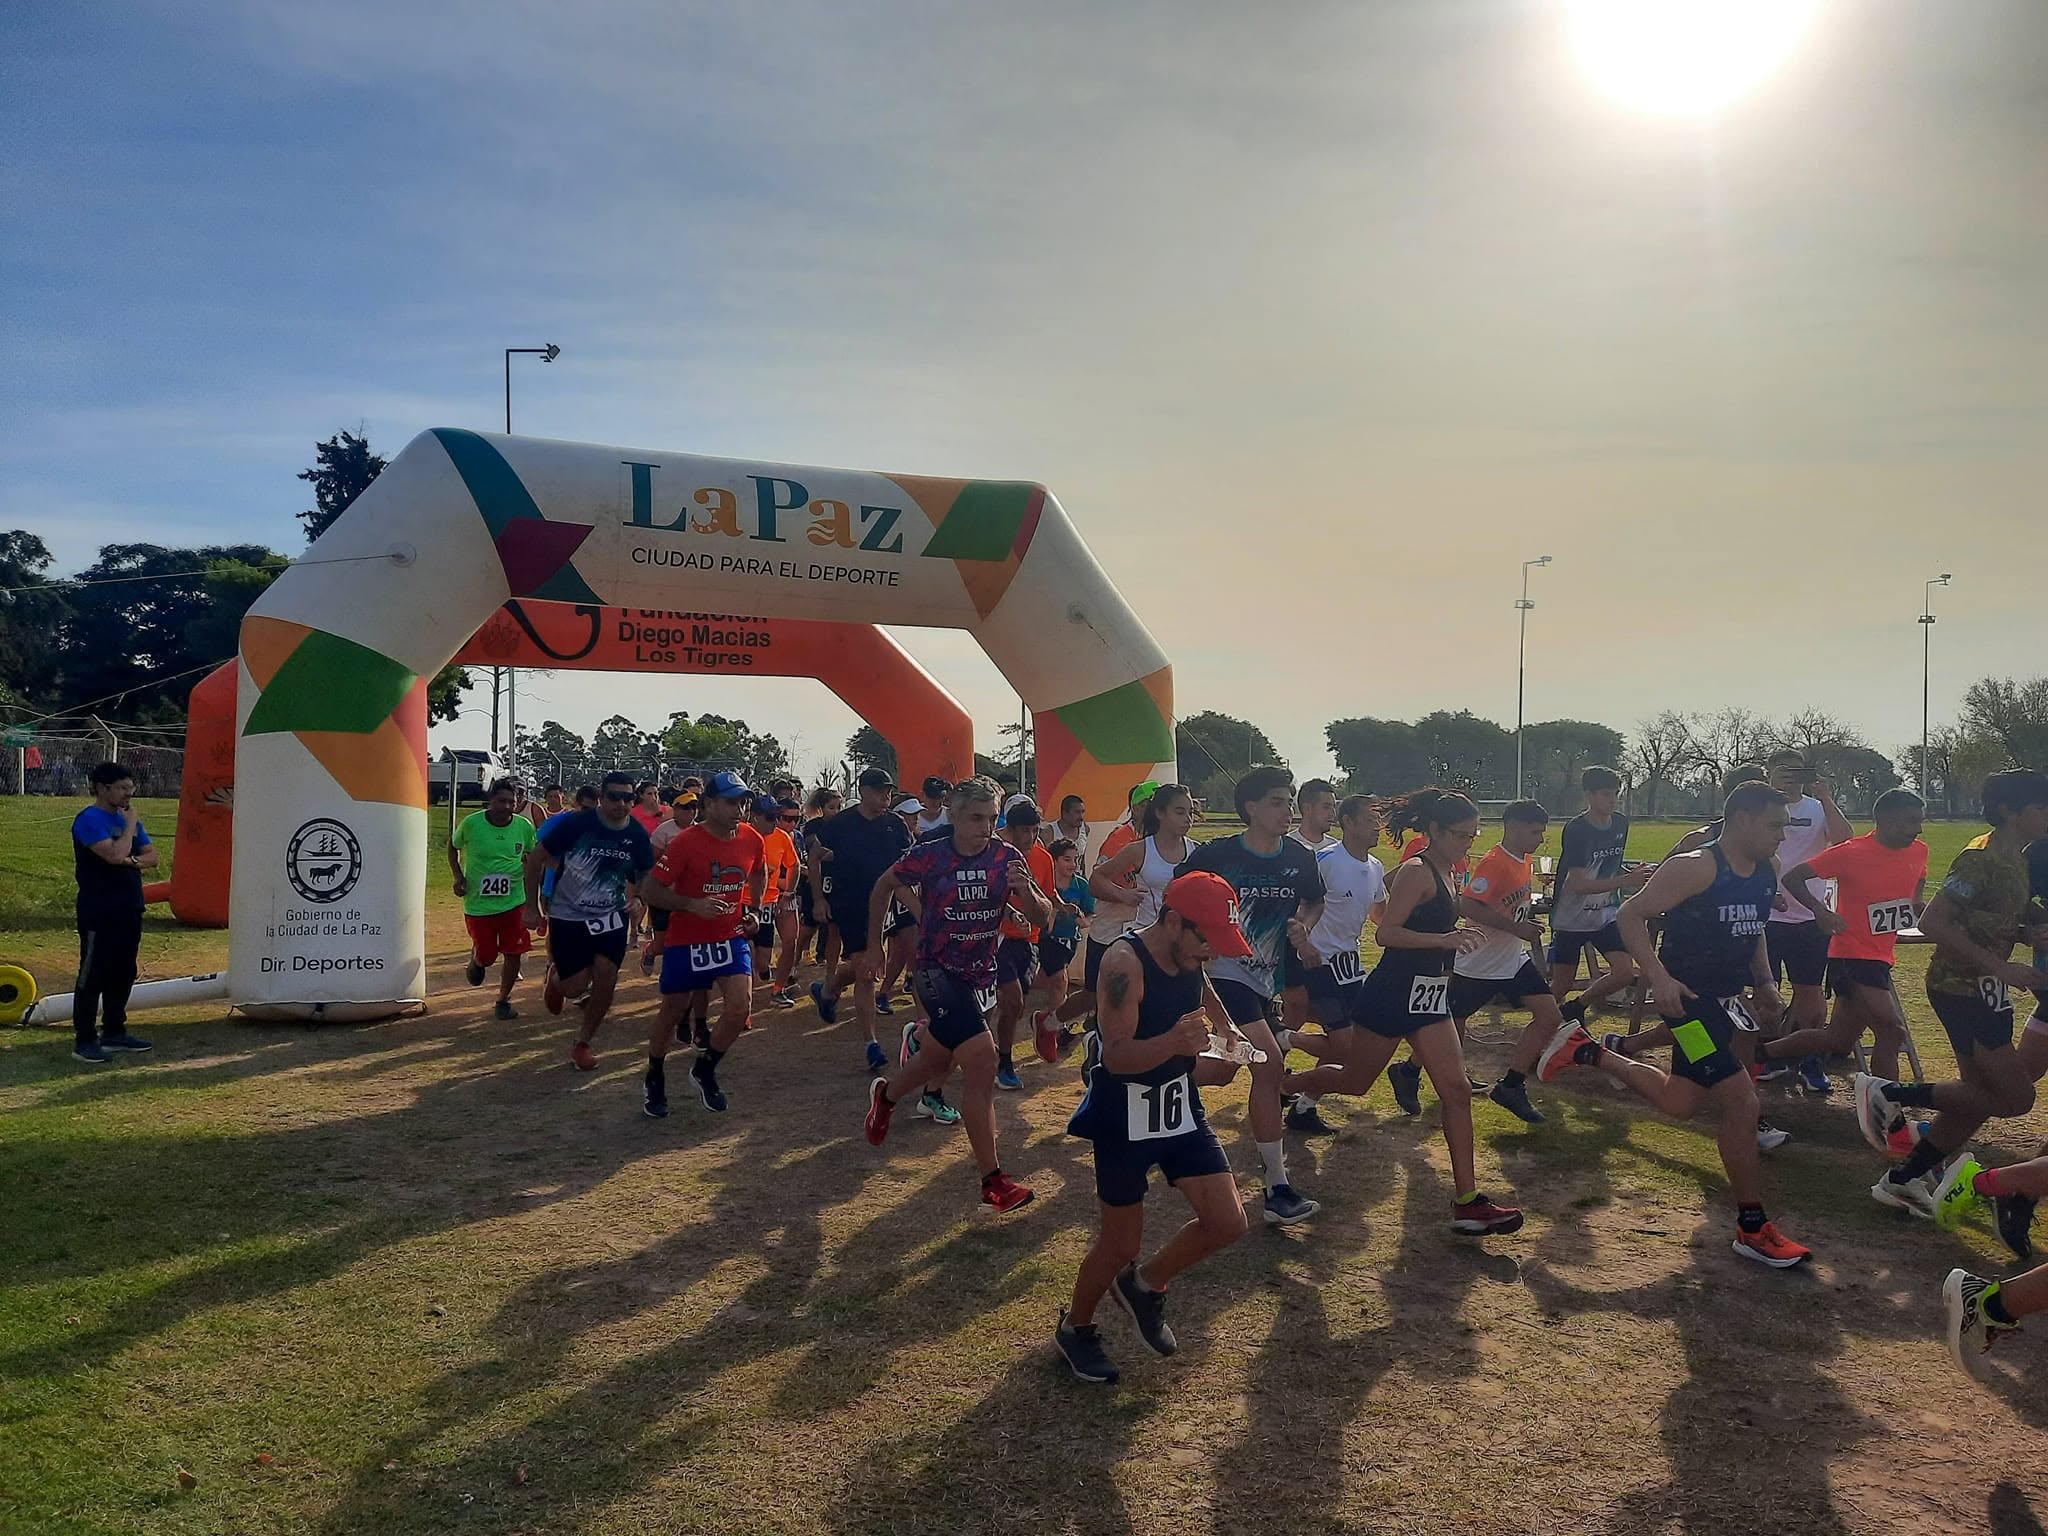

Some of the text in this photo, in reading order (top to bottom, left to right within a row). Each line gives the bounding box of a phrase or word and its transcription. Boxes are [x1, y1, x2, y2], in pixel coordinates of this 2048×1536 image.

[631, 547, 900, 587] CIUDAD PARA EL DEPORTE
[618, 621, 771, 648] Diego Macias
[635, 645, 753, 667] Los Tigres
[590, 848, 631, 861] PASEOS
[481, 878, 509, 895] 248
[958, 885, 989, 901] LA PAZ
[286, 908, 361, 921] Gobierno de
[1718, 904, 1758, 922] TEAM
[1872, 904, 1913, 932] 275
[265, 923, 382, 938] la Ciudad de La Paz
[261, 955, 384, 975] Dir. Deportes
[691, 940, 729, 968] 36
[1328, 950, 1366, 981] 102
[1411, 984, 1446, 1011] 237
[1141, 1081, 1183, 1133] 16
